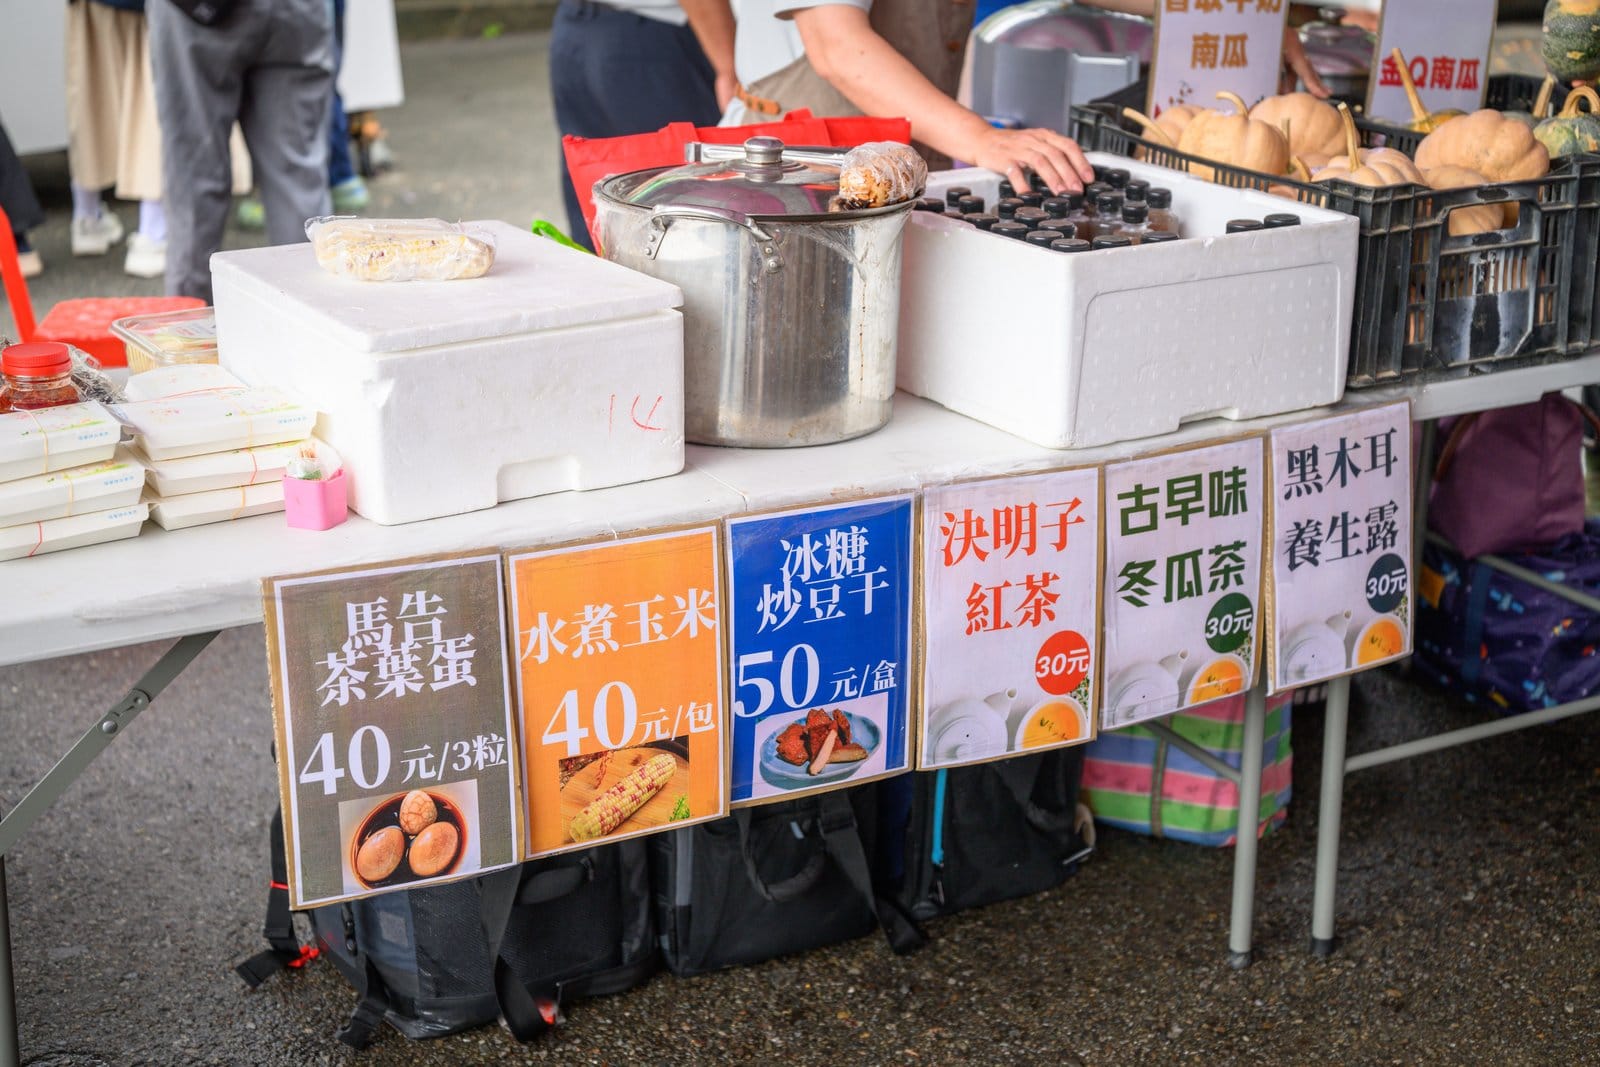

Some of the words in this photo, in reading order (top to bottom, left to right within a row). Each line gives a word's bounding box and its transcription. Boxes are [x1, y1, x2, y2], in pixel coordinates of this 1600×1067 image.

[1190, 32, 1248, 69] 南瓜
[1284, 427, 1398, 500] 黑木耳
[940, 497, 1085, 567] 決明子
[1117, 466, 1248, 536] 古早味
[780, 526, 869, 583] 冰糖
[1284, 500, 1399, 572] 養生露
[756, 566, 889, 634] 炒豆干
[965, 572, 1061, 636] 紅茶
[1116, 540, 1247, 608] 冬瓜茶
[1366, 568, 1407, 599] 30元
[341, 590, 448, 656] 馬告
[520, 588, 717, 664] 水煮玉米
[1206, 608, 1252, 639] 30元
[315, 633, 477, 707] 茶葉蛋
[1036, 648, 1089, 678] 30元
